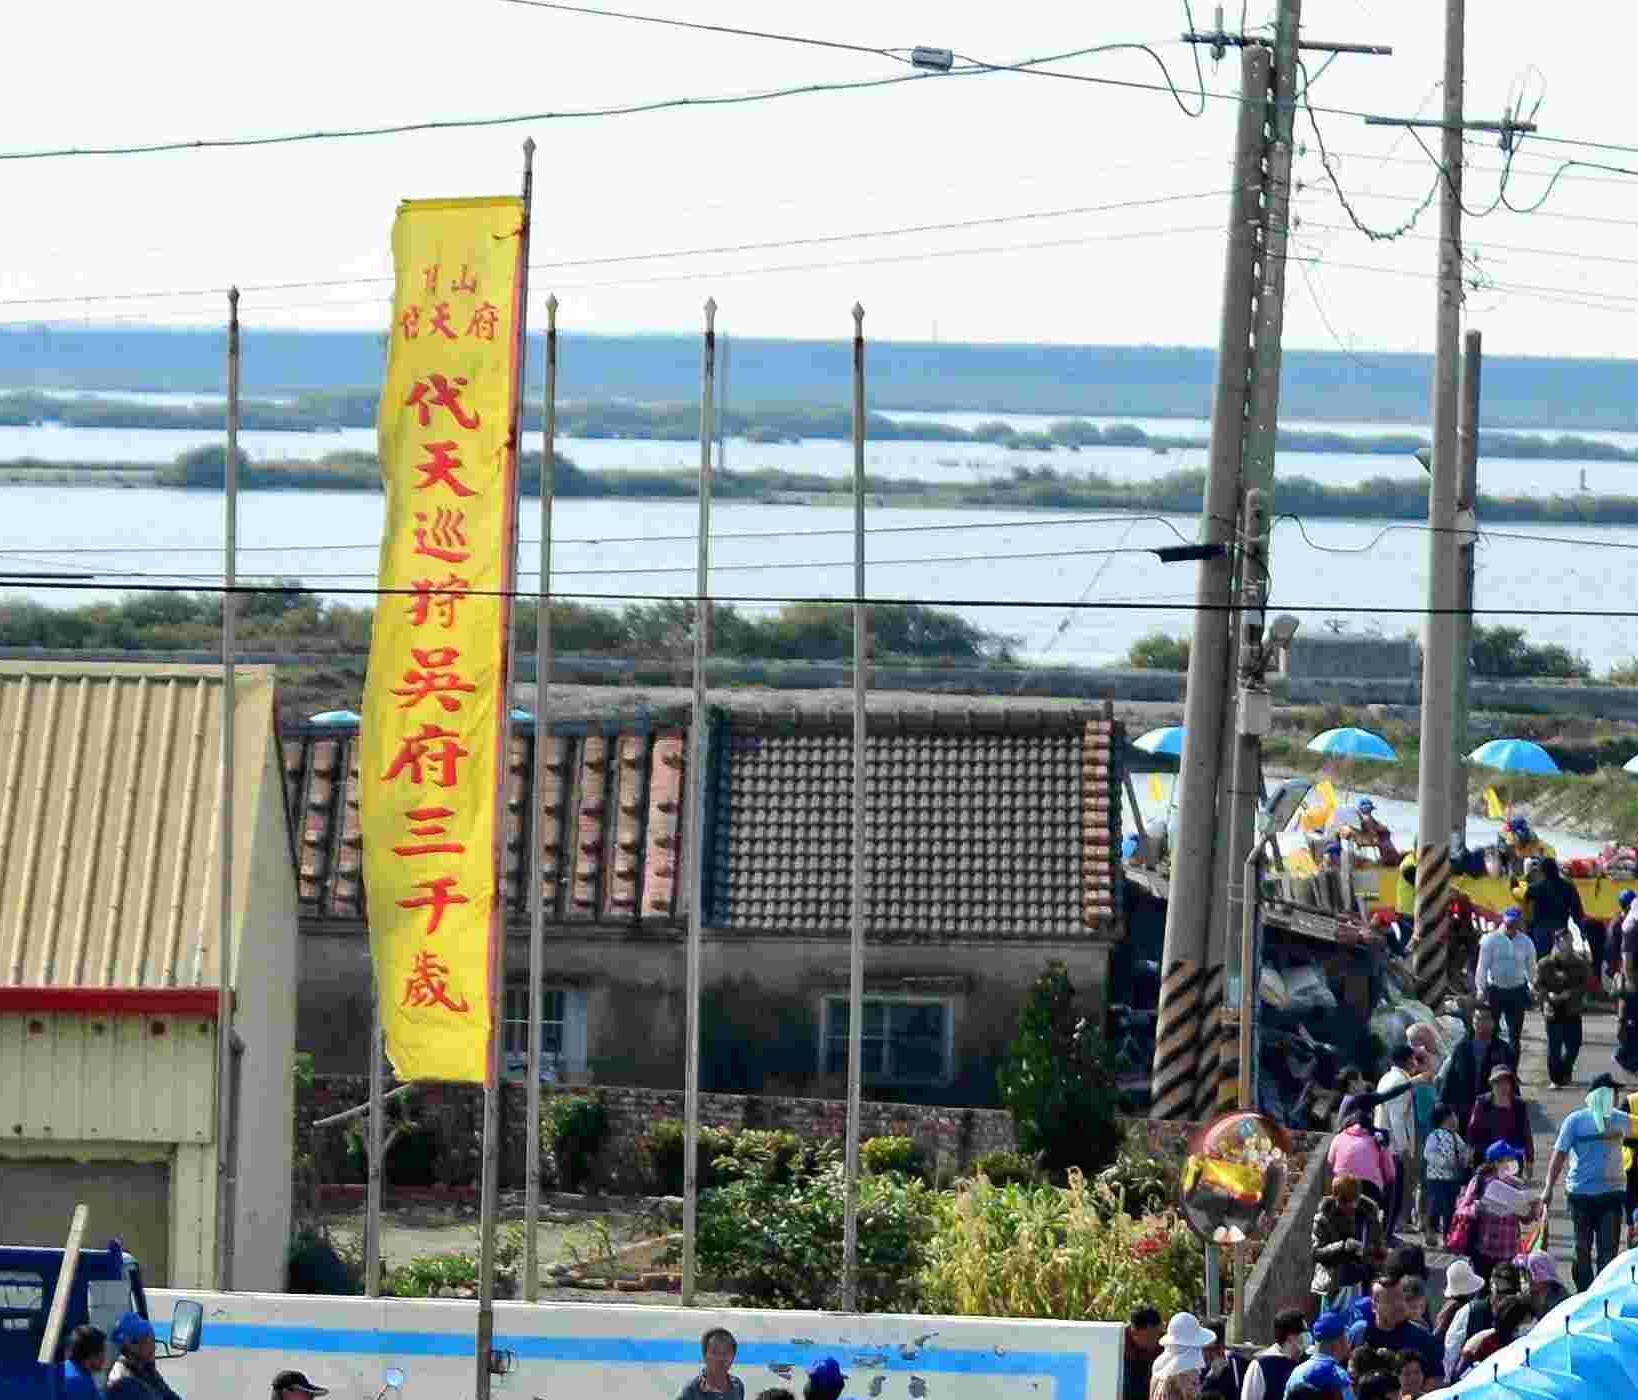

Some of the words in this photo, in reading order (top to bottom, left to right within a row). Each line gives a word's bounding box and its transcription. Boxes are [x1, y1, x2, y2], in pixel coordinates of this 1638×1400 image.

[381, 374, 479, 1013] 代天巡狩吳府三千歲
